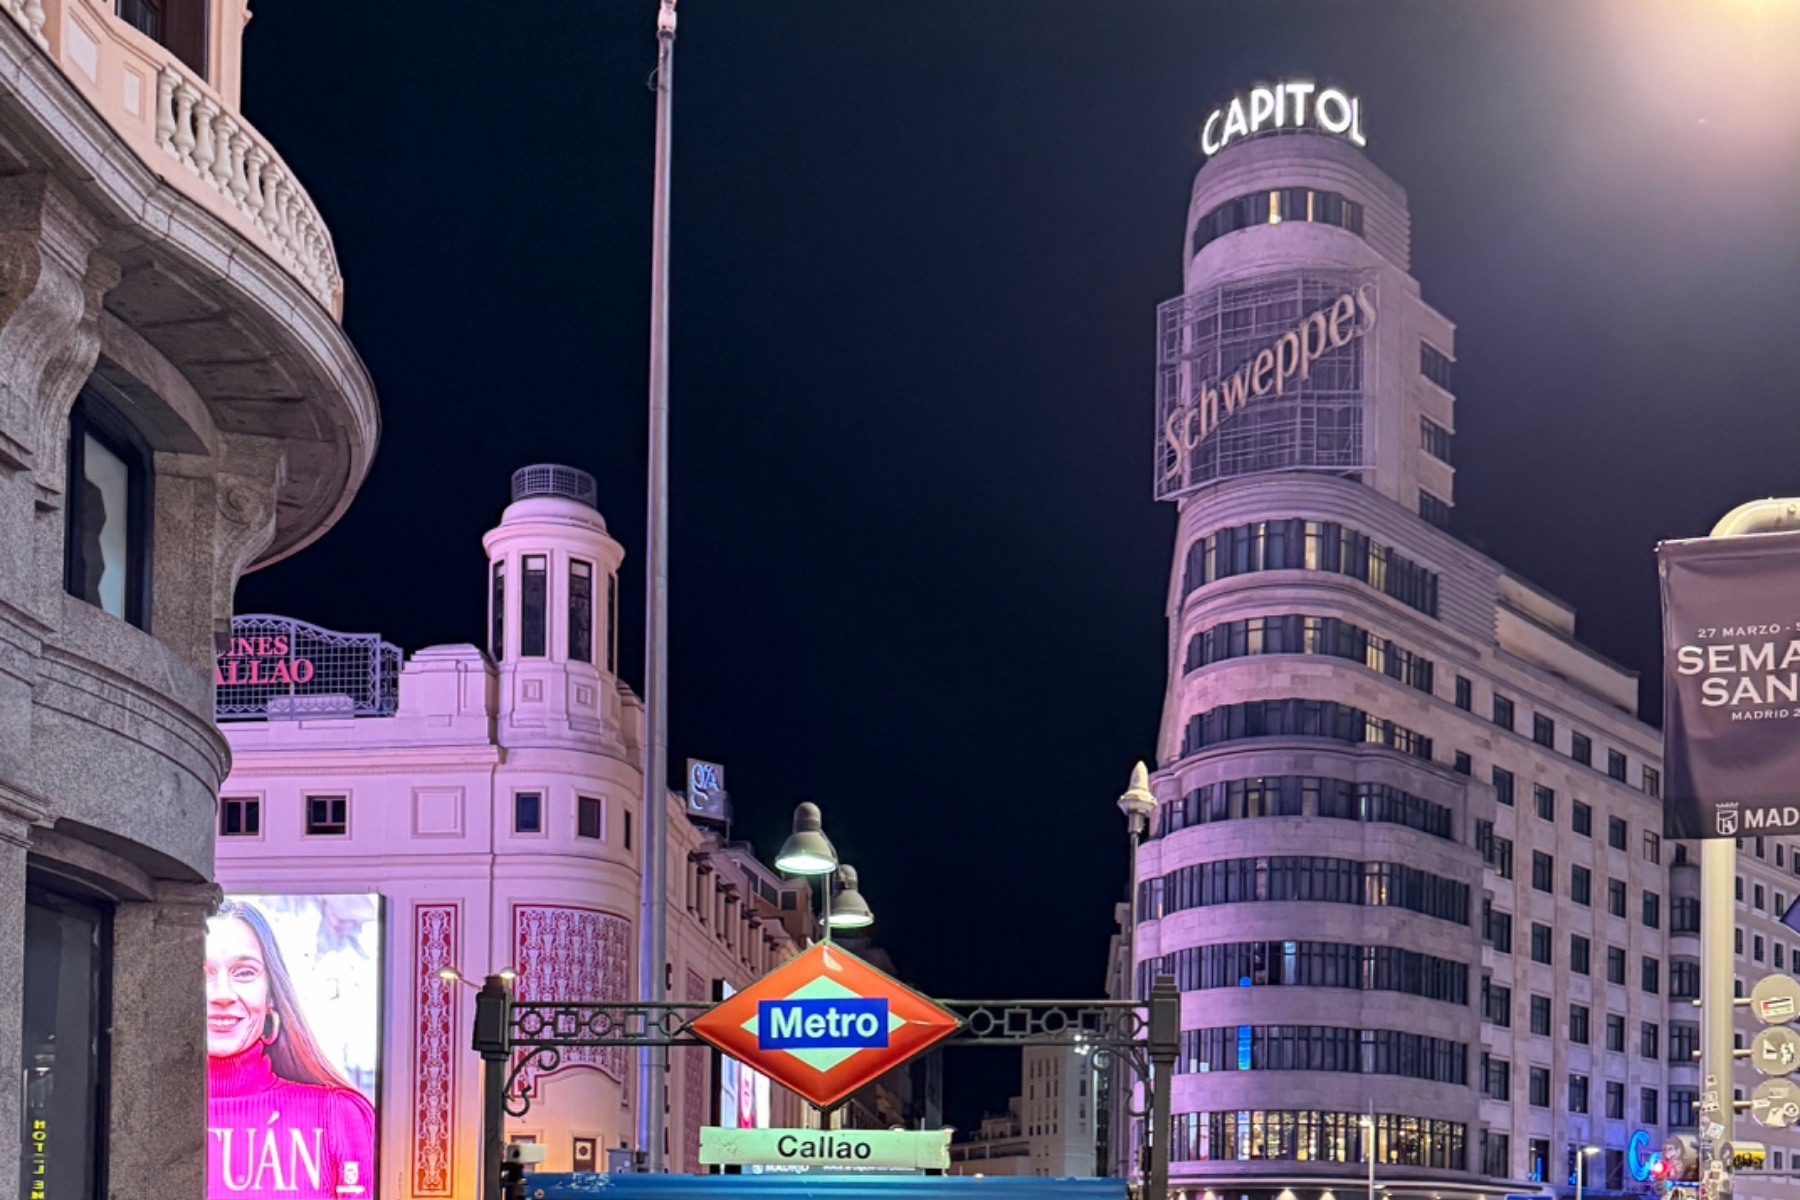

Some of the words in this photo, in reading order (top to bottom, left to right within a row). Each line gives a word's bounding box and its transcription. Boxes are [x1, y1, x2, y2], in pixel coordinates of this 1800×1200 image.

[1201, 82, 1367, 157] CAPITOL
[1163, 280, 1379, 481] Schweppes
[1697, 628, 1717, 638] 27
[1722, 623, 1780, 637] MARZO
[217, 635, 288, 658] INES
[1701, 672, 1798, 707] SAN
[1731, 709, 1789, 720] MADRID
[1744, 807, 1800, 829] MAD
[771, 1006, 879, 1039] Metro
[777, 1134, 871, 1159] Callao
